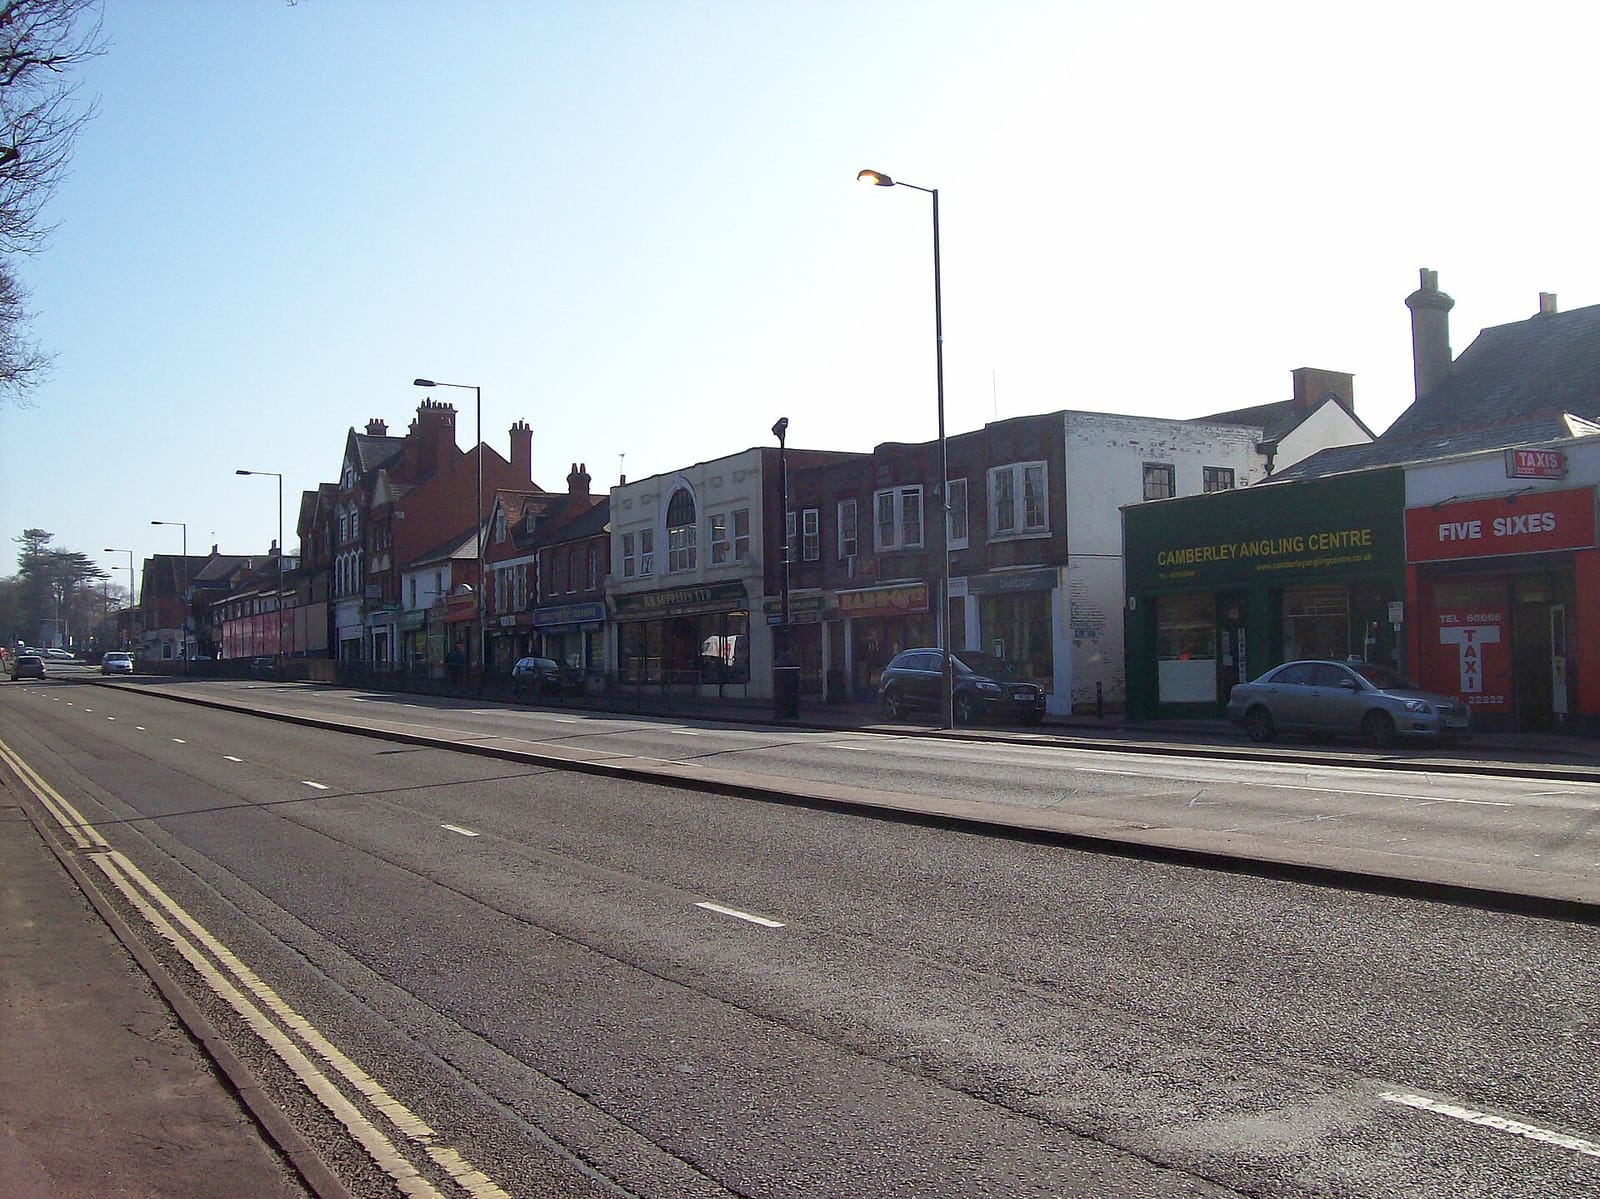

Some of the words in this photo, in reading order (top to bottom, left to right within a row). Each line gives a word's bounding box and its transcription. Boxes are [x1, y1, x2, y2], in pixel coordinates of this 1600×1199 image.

[1518, 452, 1557, 468] TAXIS
[1439, 520, 1482, 542] FIVE
[1492, 511, 1556, 537] SIXES
[1157, 543, 1238, 566] CAMBERLEY
[1239, 536, 1304, 558] ANGLING
[1308, 529, 1373, 551] CENTRE
[694, 589, 712, 601] LTD
[1440, 614, 1460, 623] TEL
[1463, 629, 1478, 689] TAXI
[1467, 695, 1505, 704] 22222
